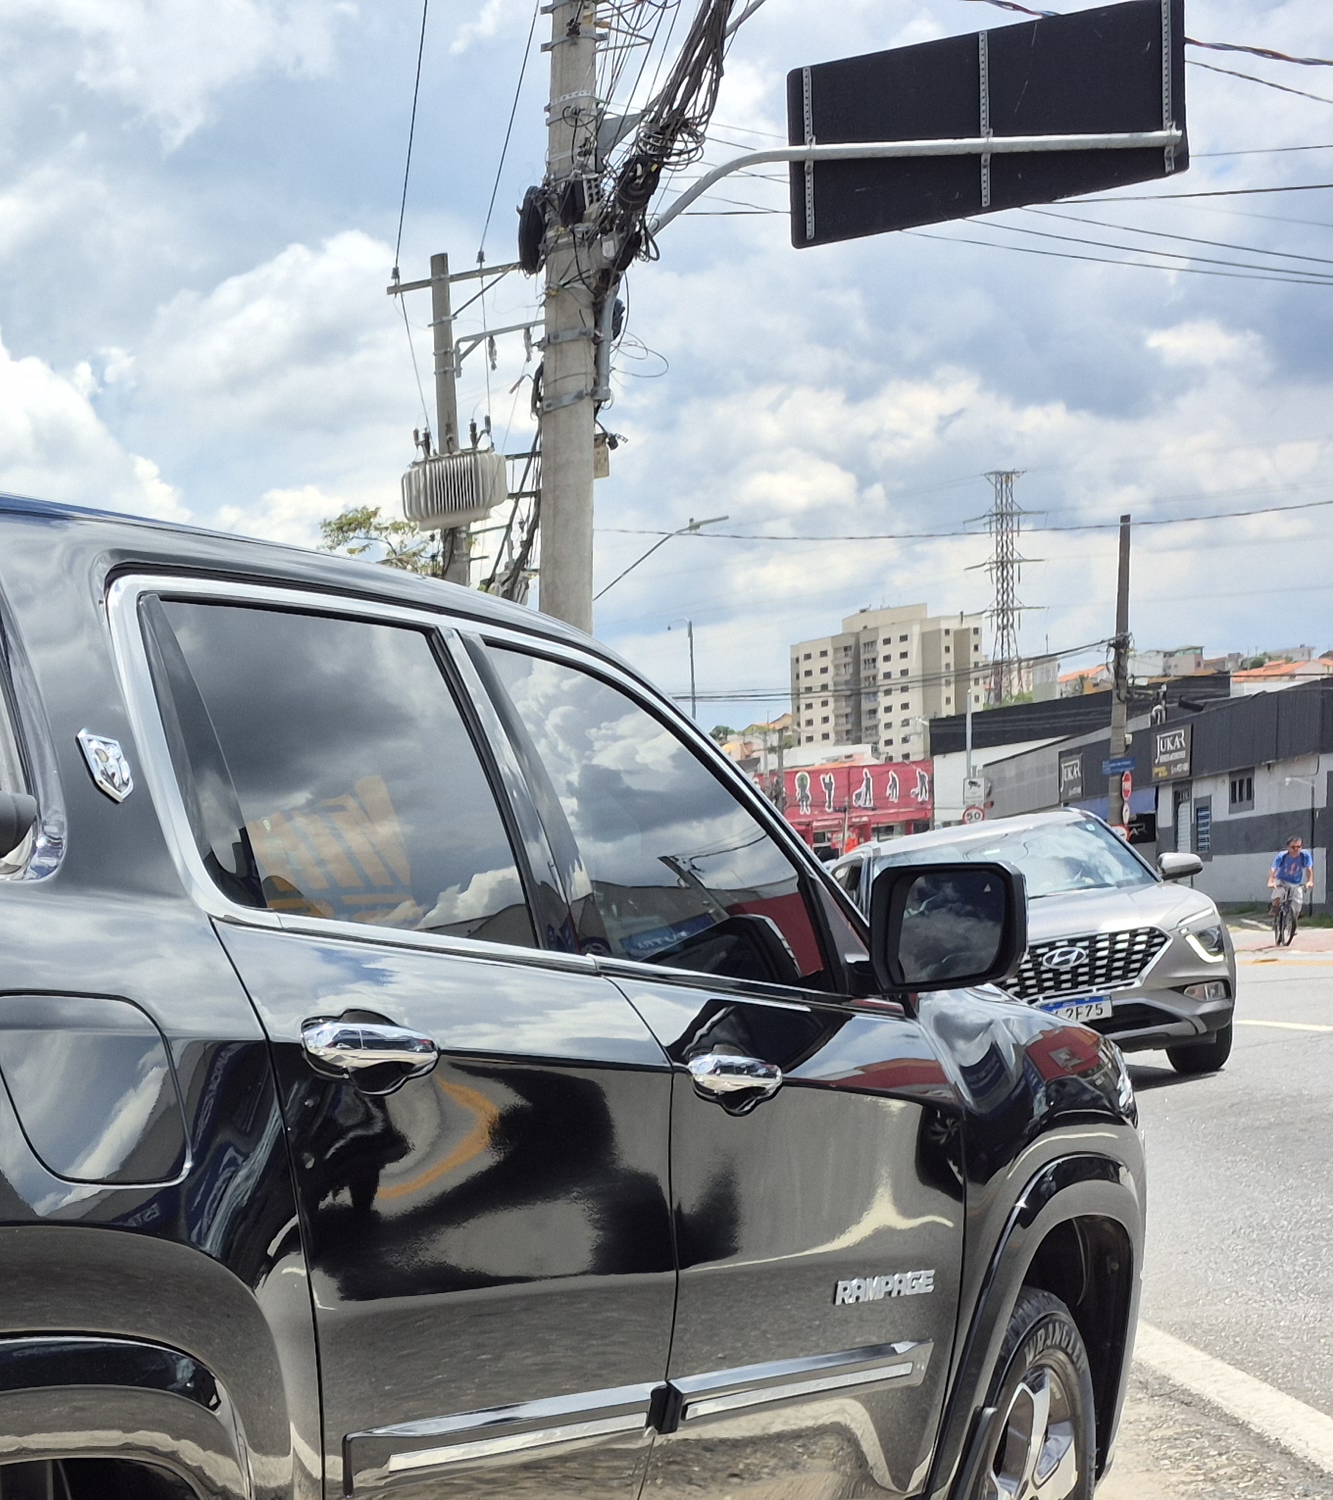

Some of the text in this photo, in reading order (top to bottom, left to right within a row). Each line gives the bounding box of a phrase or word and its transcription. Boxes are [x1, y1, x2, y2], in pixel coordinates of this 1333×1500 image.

[1154, 729, 1186, 765] JUKAR
[966, 810, 981, 821] 50
[834, 1269, 935, 1306] RAMPAGE
